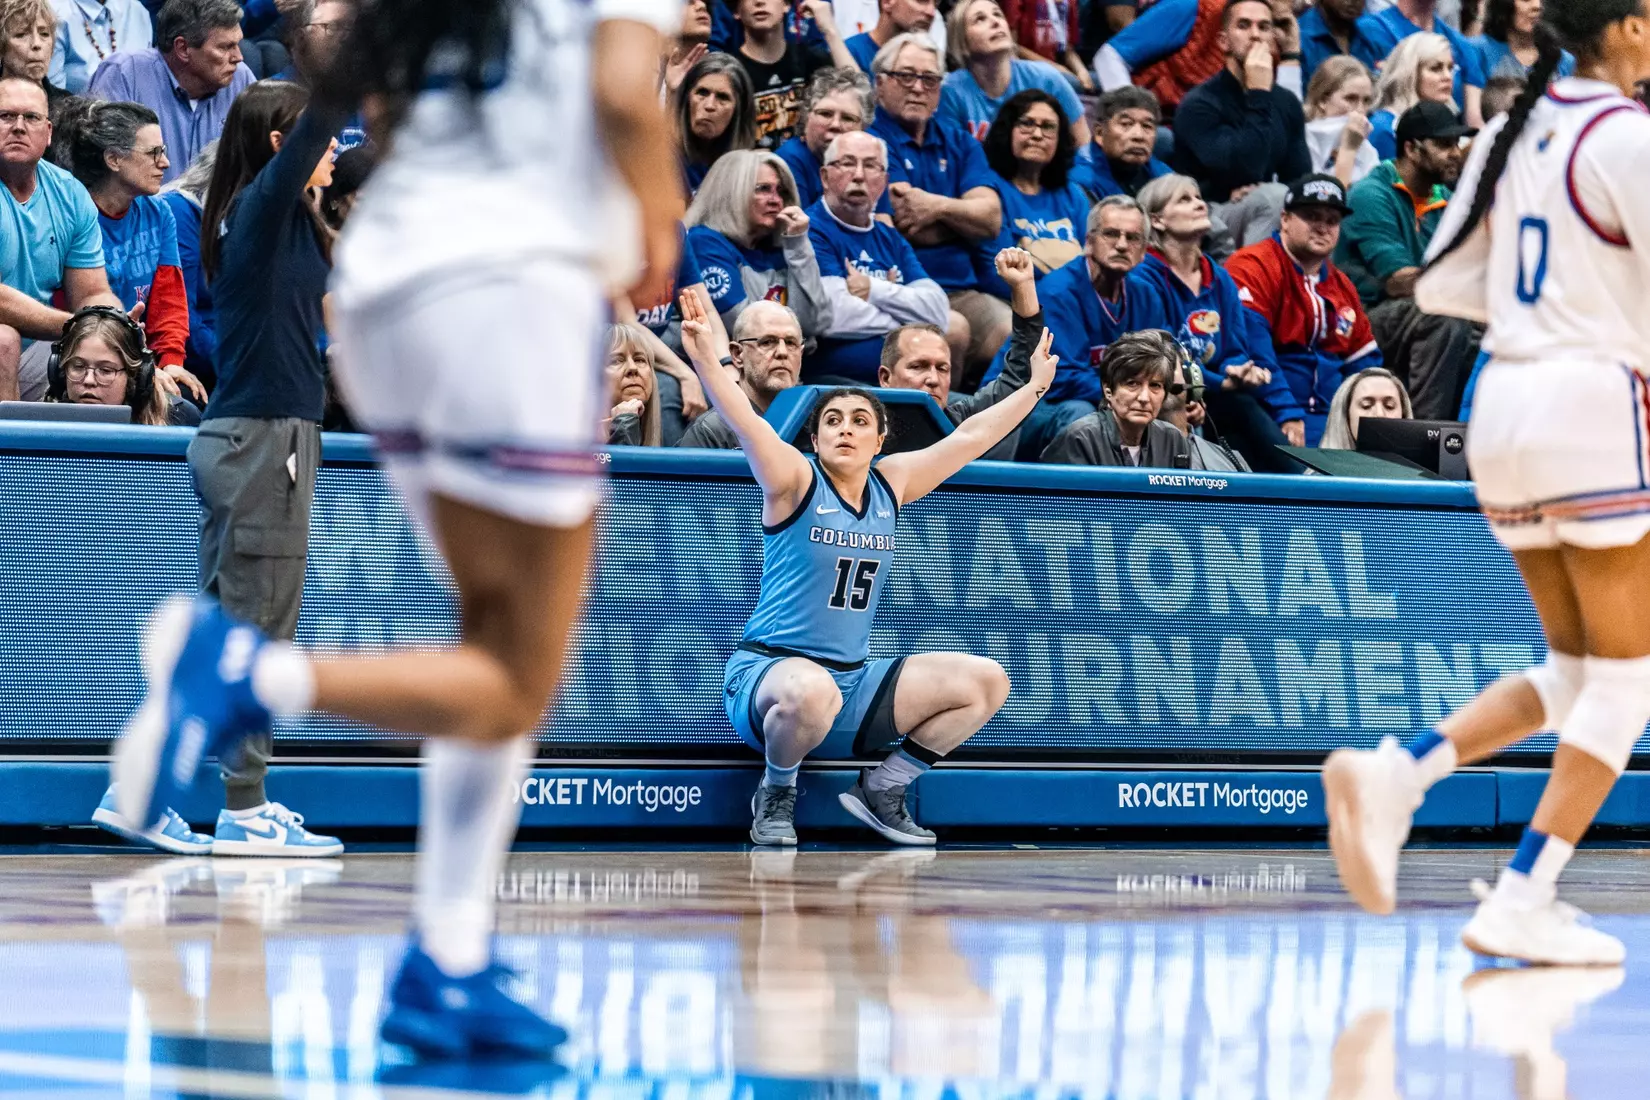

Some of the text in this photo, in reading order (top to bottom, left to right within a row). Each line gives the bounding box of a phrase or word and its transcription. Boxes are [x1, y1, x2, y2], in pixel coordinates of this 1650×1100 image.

[704, 275, 722, 289] KU
[1515, 216, 1549, 304] 0
[1148, 474, 1228, 490] ROCKET Mortgage
[827, 556, 881, 612] 15
[890, 514, 1398, 621] NATIONAL
[865, 626, 1534, 730] URNAMEN
[510, 777, 702, 813] OCKET Mortgage
[1118, 782, 1309, 815] ROCKET Mortgage
